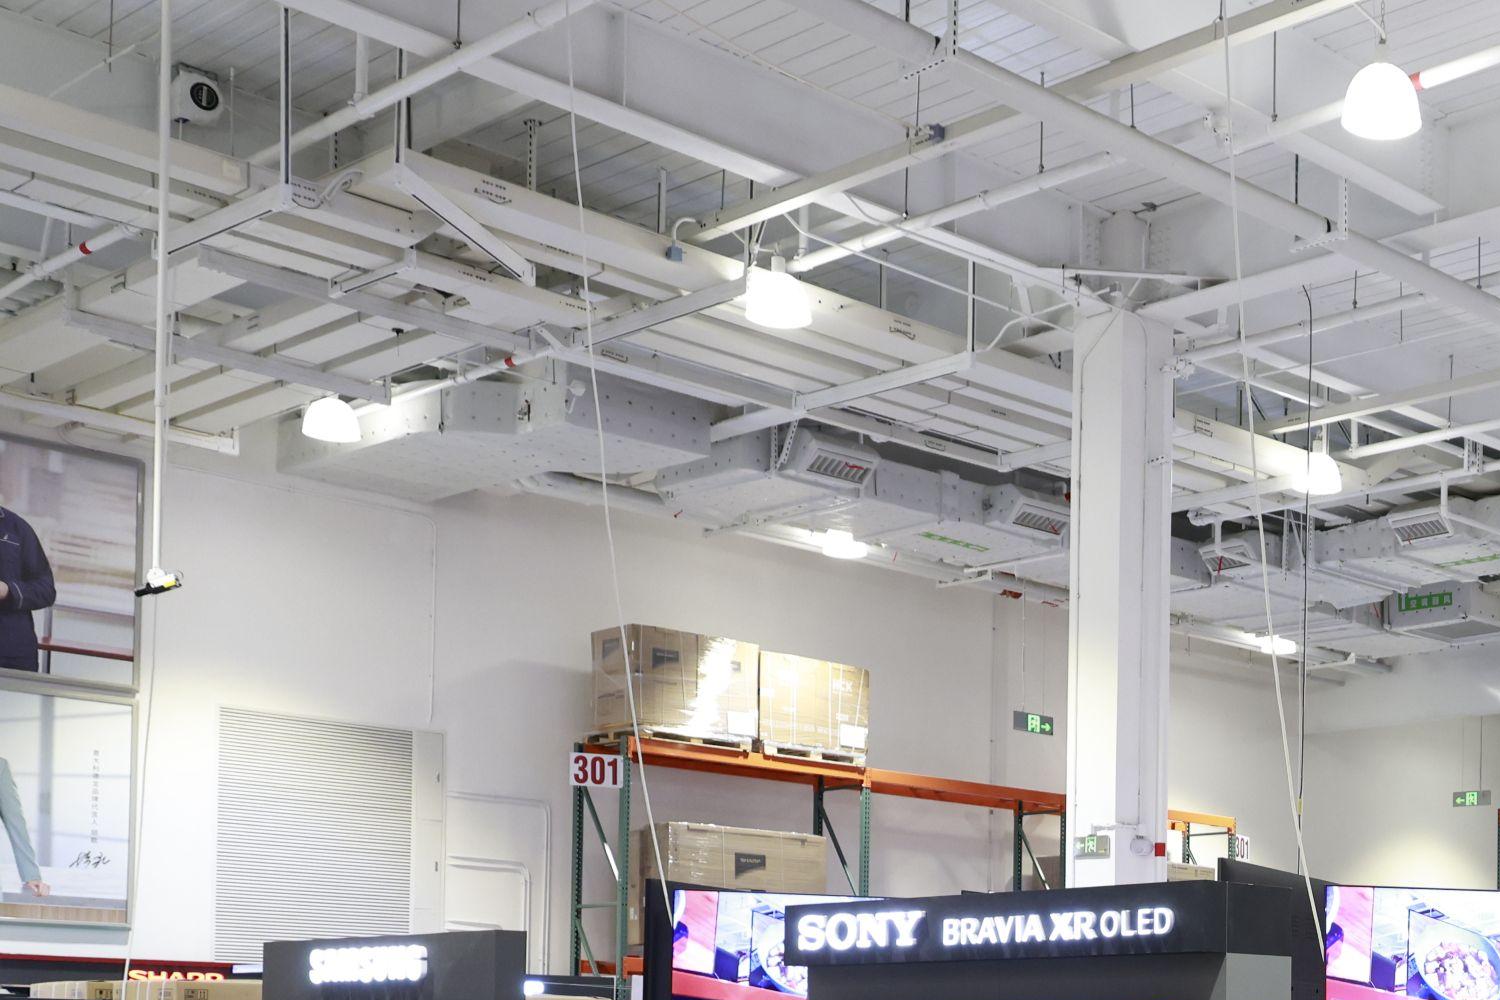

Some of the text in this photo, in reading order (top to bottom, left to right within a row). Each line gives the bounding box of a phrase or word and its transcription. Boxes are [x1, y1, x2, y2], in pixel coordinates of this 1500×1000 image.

[573, 755, 618, 785] 301
[1236, 836, 1248, 859] 301
[797, 906, 1175, 951] SONY BRAVIA XR OLED
